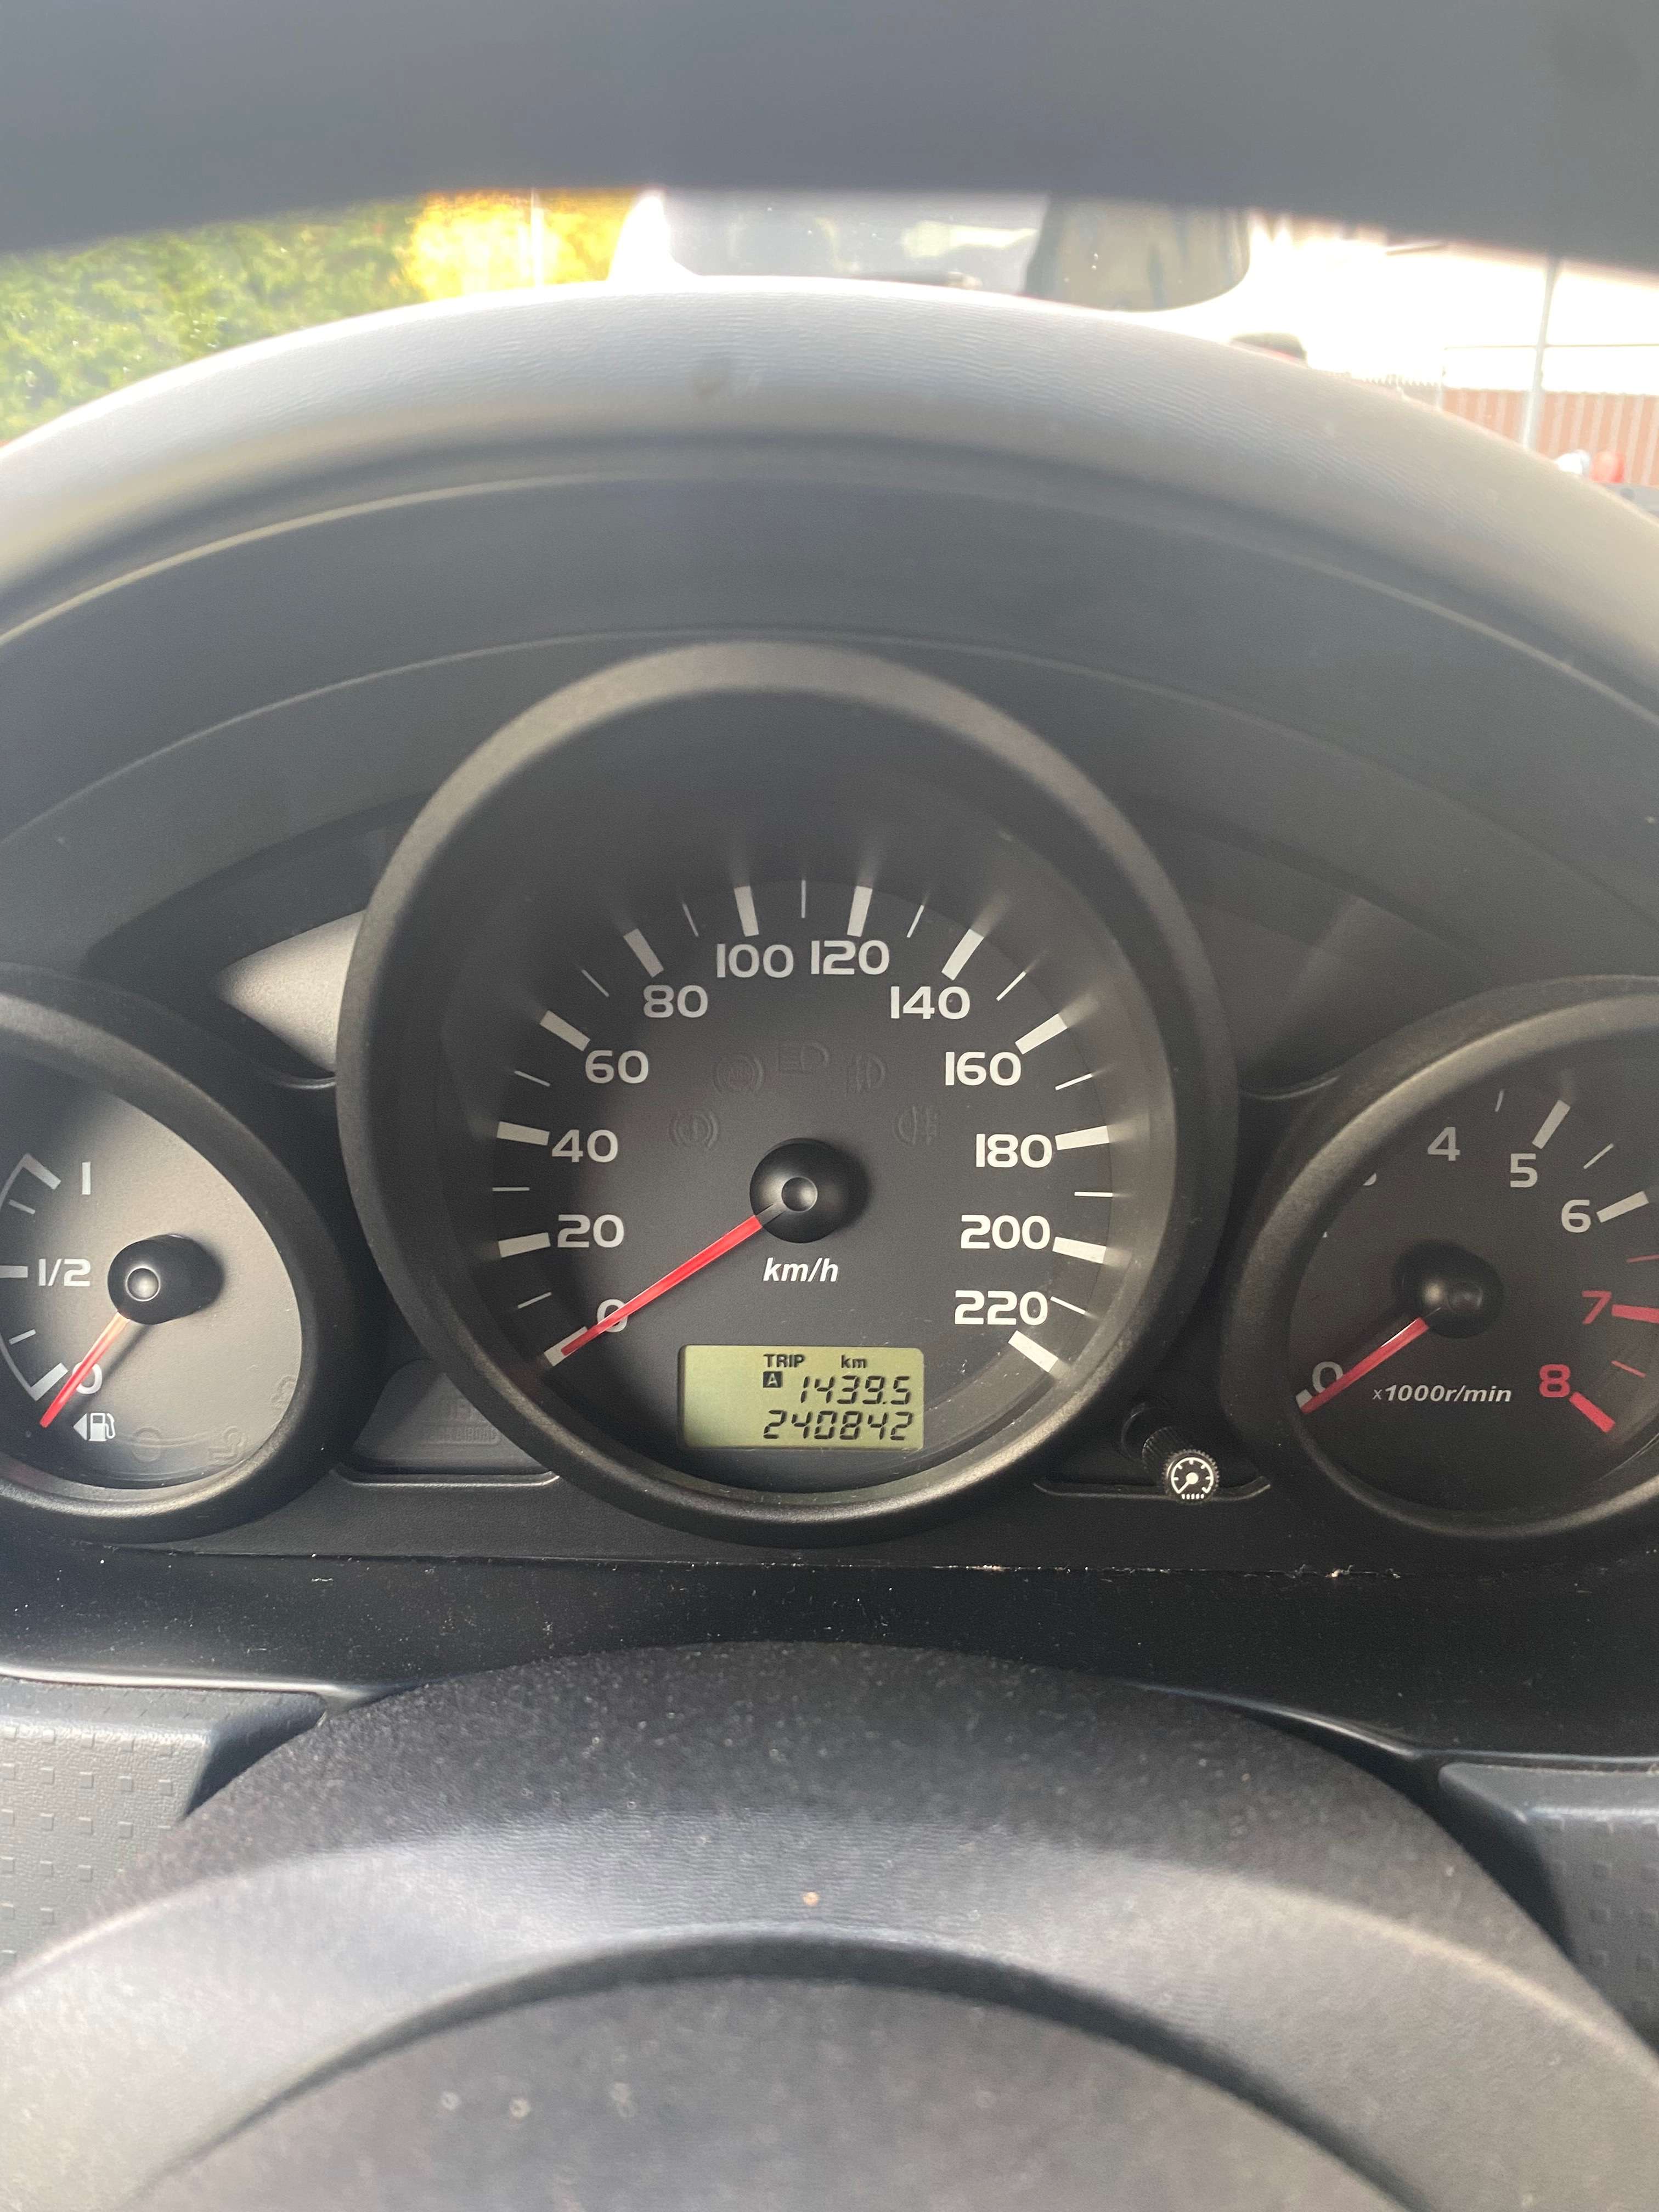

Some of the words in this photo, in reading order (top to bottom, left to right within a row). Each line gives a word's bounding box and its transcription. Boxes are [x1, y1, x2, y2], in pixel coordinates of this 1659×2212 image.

[716, 943, 794, 978] 100
[810, 940, 890, 975] 120
[643, 985, 708, 1018] 80
[890, 986, 970, 1019] 140
[584, 1050, 650, 1084] 60
[945, 1051, 1022, 1086] 160
[551, 1128, 619, 1163] 40
[975, 1133, 1053, 1168] 180
[1426, 1126, 1461, 1161] 4
[81, 1161, 91, 1195] 1
[1510, 1153, 1538, 1188] 5
[556, 1214, 625, 1248] 20
[961, 1214, 1051, 1250] 200
[1560, 1199, 1592, 1233] 6
[38, 1258, 91, 1286] 1/2
[763, 1257, 839, 1282] km/h
[596, 1299, 629, 1333] 0
[954, 1289, 1048, 1325] 220
[1581, 1290, 1612, 1325] 7
[763, 1354, 806, 1368] TRIP
[840, 1355, 867, 1369] km
[1311, 1361, 1344, 1395] 0
[766, 1373, 780, 1387] A
[800, 1375, 911, 1405] 1439.5
[1539, 1364, 1571, 1398] 8
[763, 1409, 913, 1441] 240842
